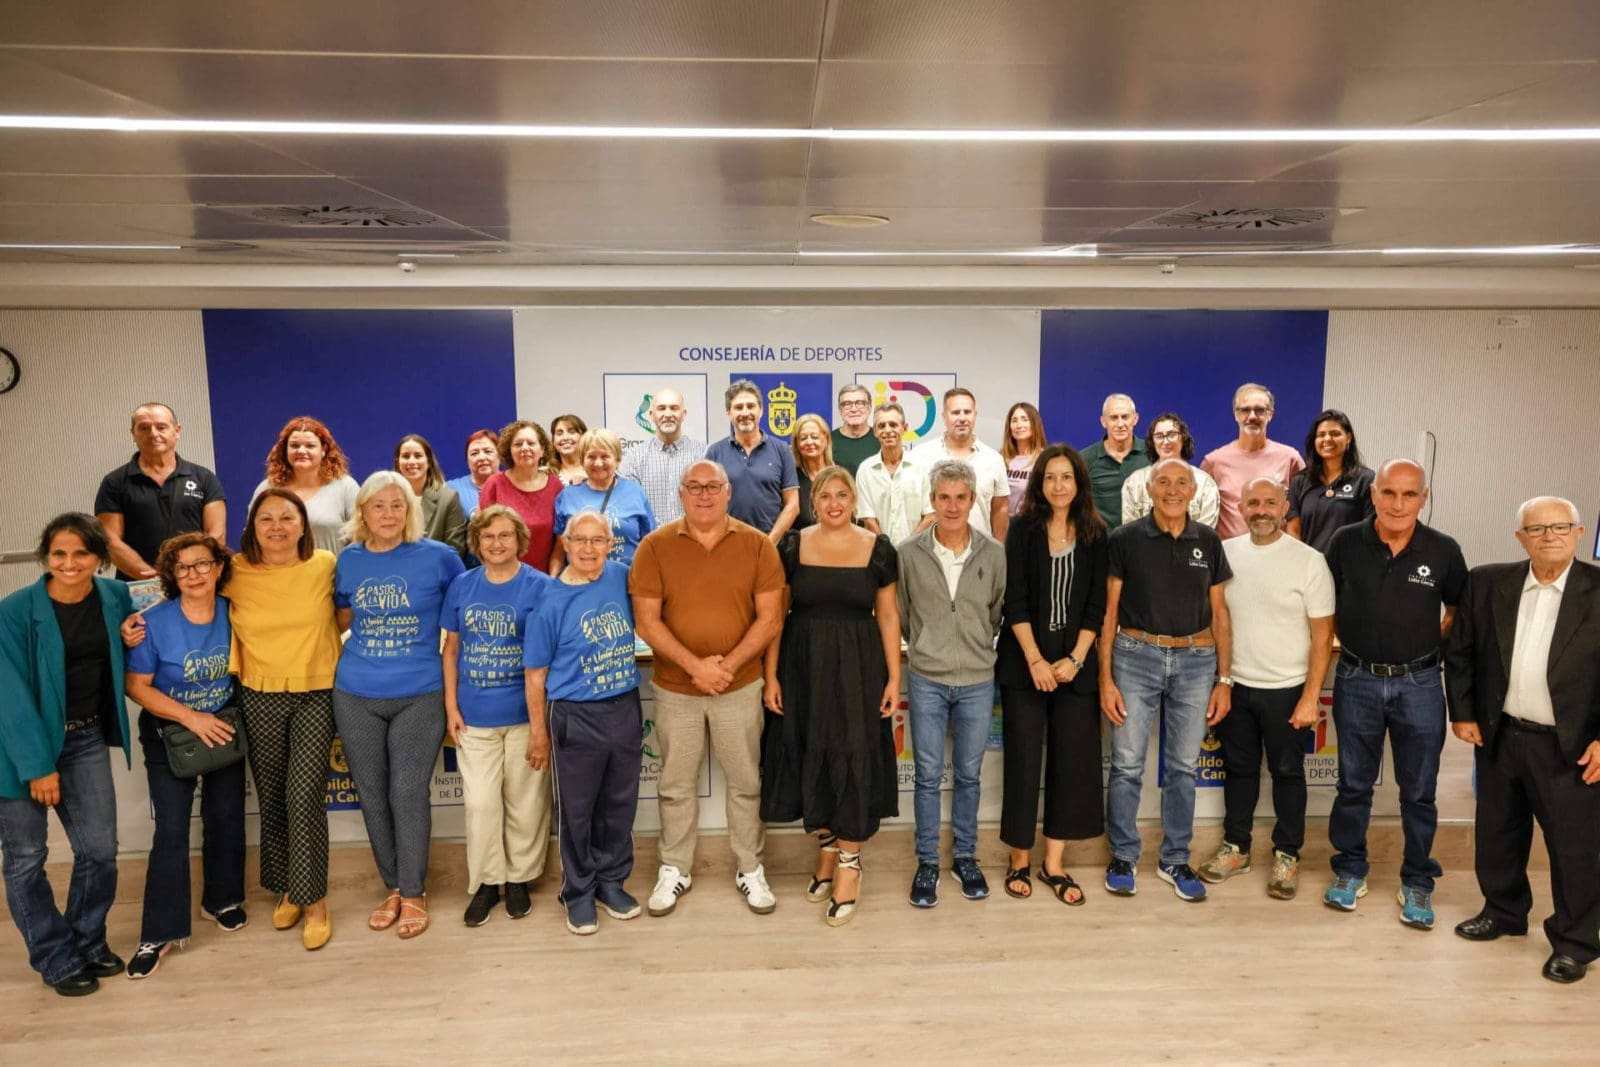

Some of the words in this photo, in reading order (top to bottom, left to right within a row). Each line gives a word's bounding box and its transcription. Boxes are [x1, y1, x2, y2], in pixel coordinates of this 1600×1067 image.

[679, 345, 775, 361] CONSEJERÍA
[780, 348, 800, 361] DE
[804, 347, 883, 361] DEPORTES
[620, 437, 644, 449] Gra
[366, 583, 396, 597] PASOS
[379, 592, 411, 610] VIDA
[475, 610, 505, 622] PASOS
[488, 621, 516, 637] VIDA
[603, 619, 632, 640] VIDA
[195, 653, 226, 671] PASOS
[1198, 756, 1224, 768] ildo
[1304, 758, 1335, 767] TITUTO
[435, 776, 462, 785] INSTIT
